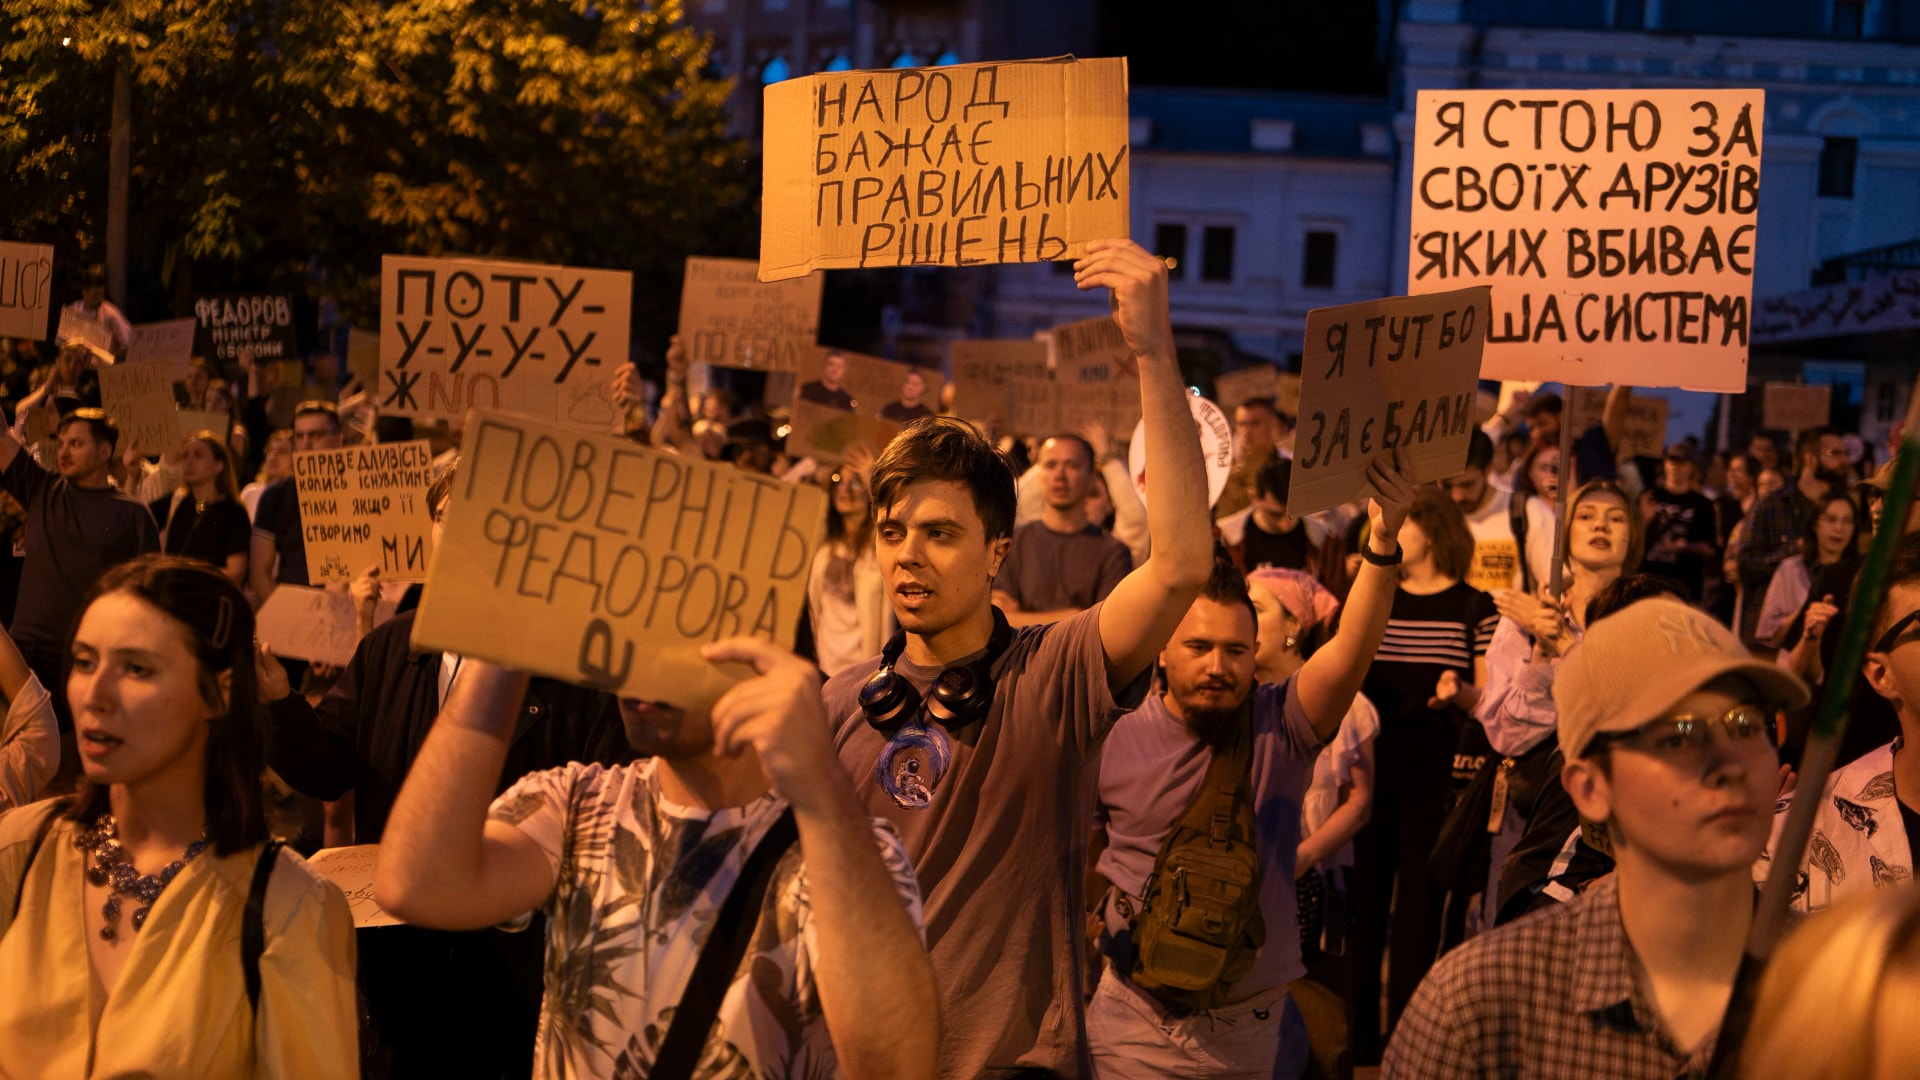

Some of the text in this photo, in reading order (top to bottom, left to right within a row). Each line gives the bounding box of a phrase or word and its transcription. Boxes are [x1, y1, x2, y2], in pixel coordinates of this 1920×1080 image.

[818, 66, 1010, 127] НАРОД
[816, 120, 994, 175] БАЖАЄ
[1433, 98, 1759, 157] Я СТОЮ ЗА
[816, 144, 1127, 227] ПРАВИЛЬНИХ
[1419, 162, 1590, 212] СВОЇХ
[1415, 224, 1756, 280] ЯКИХ ВБИВАЄ
[195, 295, 290, 328] ФЕДОРОВ
[396, 269, 605, 328] ПОТУ-
[1575, 291, 1748, 347] СИСТЕМА
[1325, 305, 1476, 380] Я ТУТ БО
[299, 474, 348, 494] КОЛИСЬ
[352, 496, 390, 516] ЯКЩО
[306, 523, 370, 545] СТВОРИМО
[381, 533, 425, 573] МИ
[484, 508, 779, 642] ФЕДОРОВА
